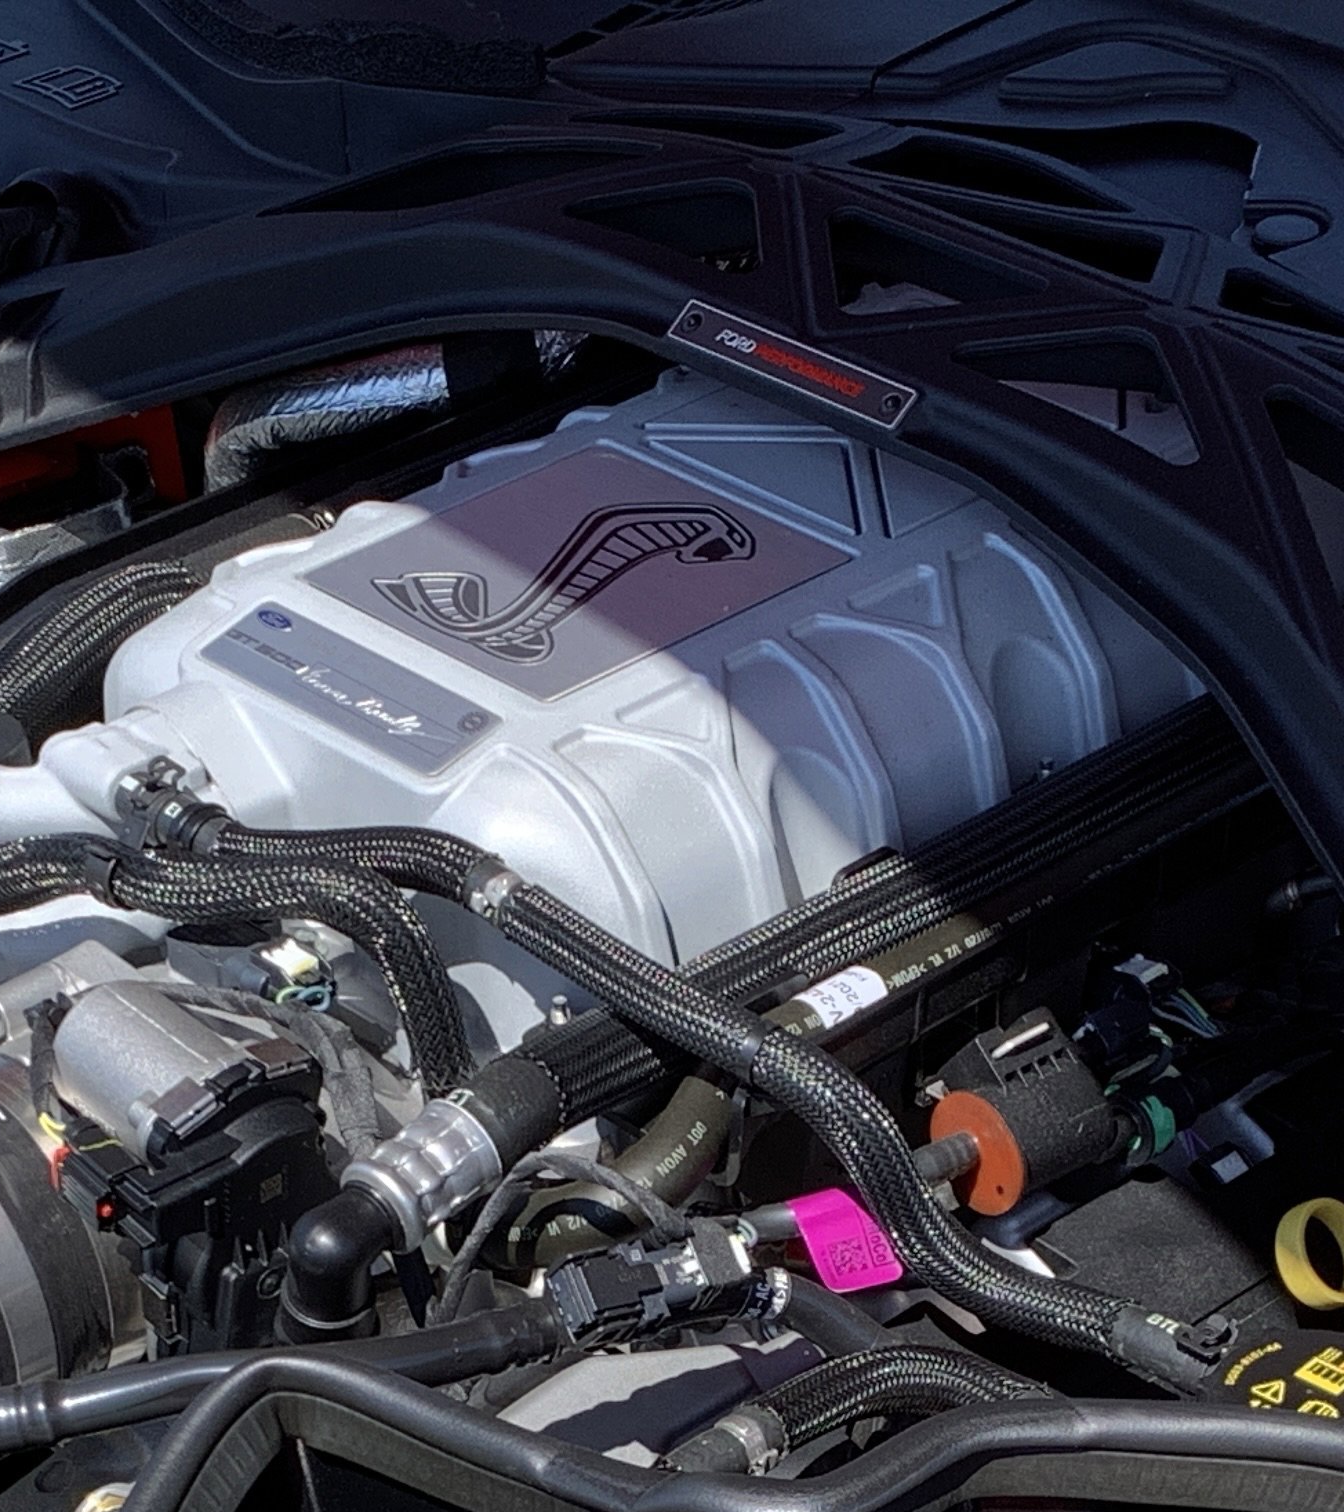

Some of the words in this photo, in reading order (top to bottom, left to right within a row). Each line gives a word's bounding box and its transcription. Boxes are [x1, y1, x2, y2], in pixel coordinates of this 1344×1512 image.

[714, 328, 756, 353] FORD
[686, 1120, 708, 1148] DOT
[656, 1143, 689, 1178] AVON
